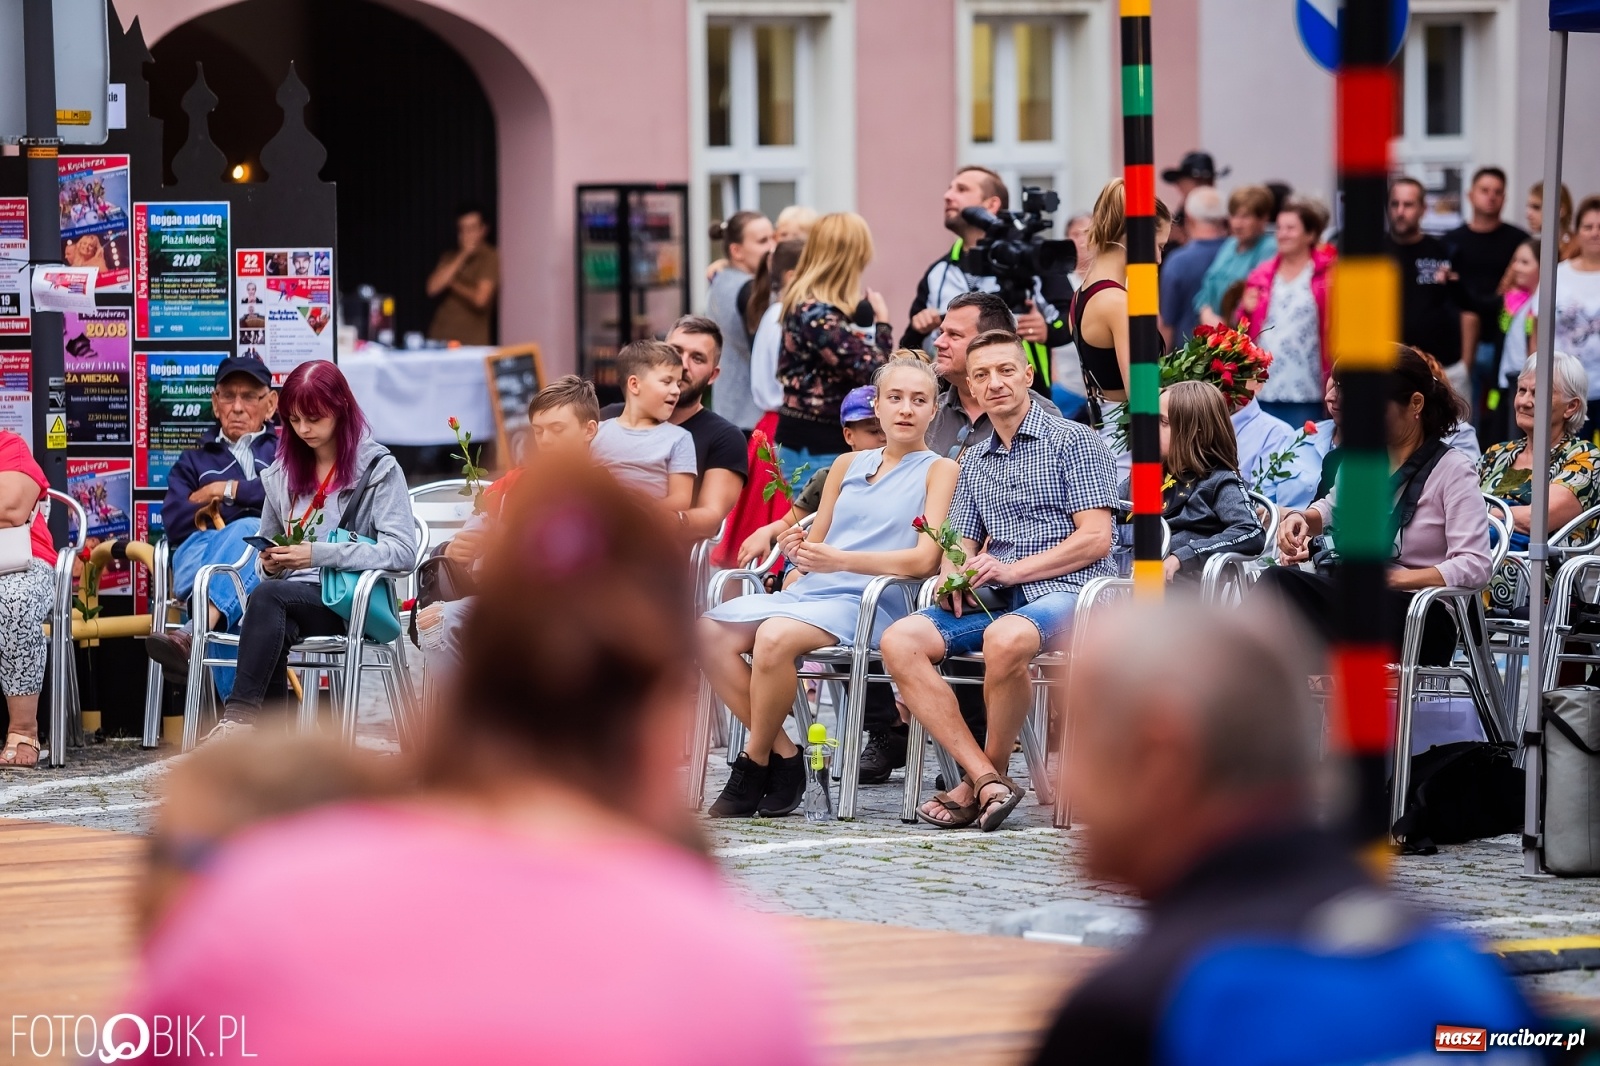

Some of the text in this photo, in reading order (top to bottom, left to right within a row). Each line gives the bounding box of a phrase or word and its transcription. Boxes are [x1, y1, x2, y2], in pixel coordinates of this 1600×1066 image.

[150, 213, 222, 229] Reggae nad Odrą
[161, 234, 216, 247] Plaża Miejska
[172, 253, 202, 267] 21.08
[244, 253, 259, 269] 22
[1, 295, 10, 305] 19
[86, 322, 128, 338] 20.08
[150, 362, 183, 376] Reggae
[184, 363, 201, 376] nad
[65, 372, 79, 383] ŻA
[81, 373, 119, 383] MIEJSKA
[161, 384, 215, 396] Plaża Miejska
[171, 403, 202, 417] 21.08
